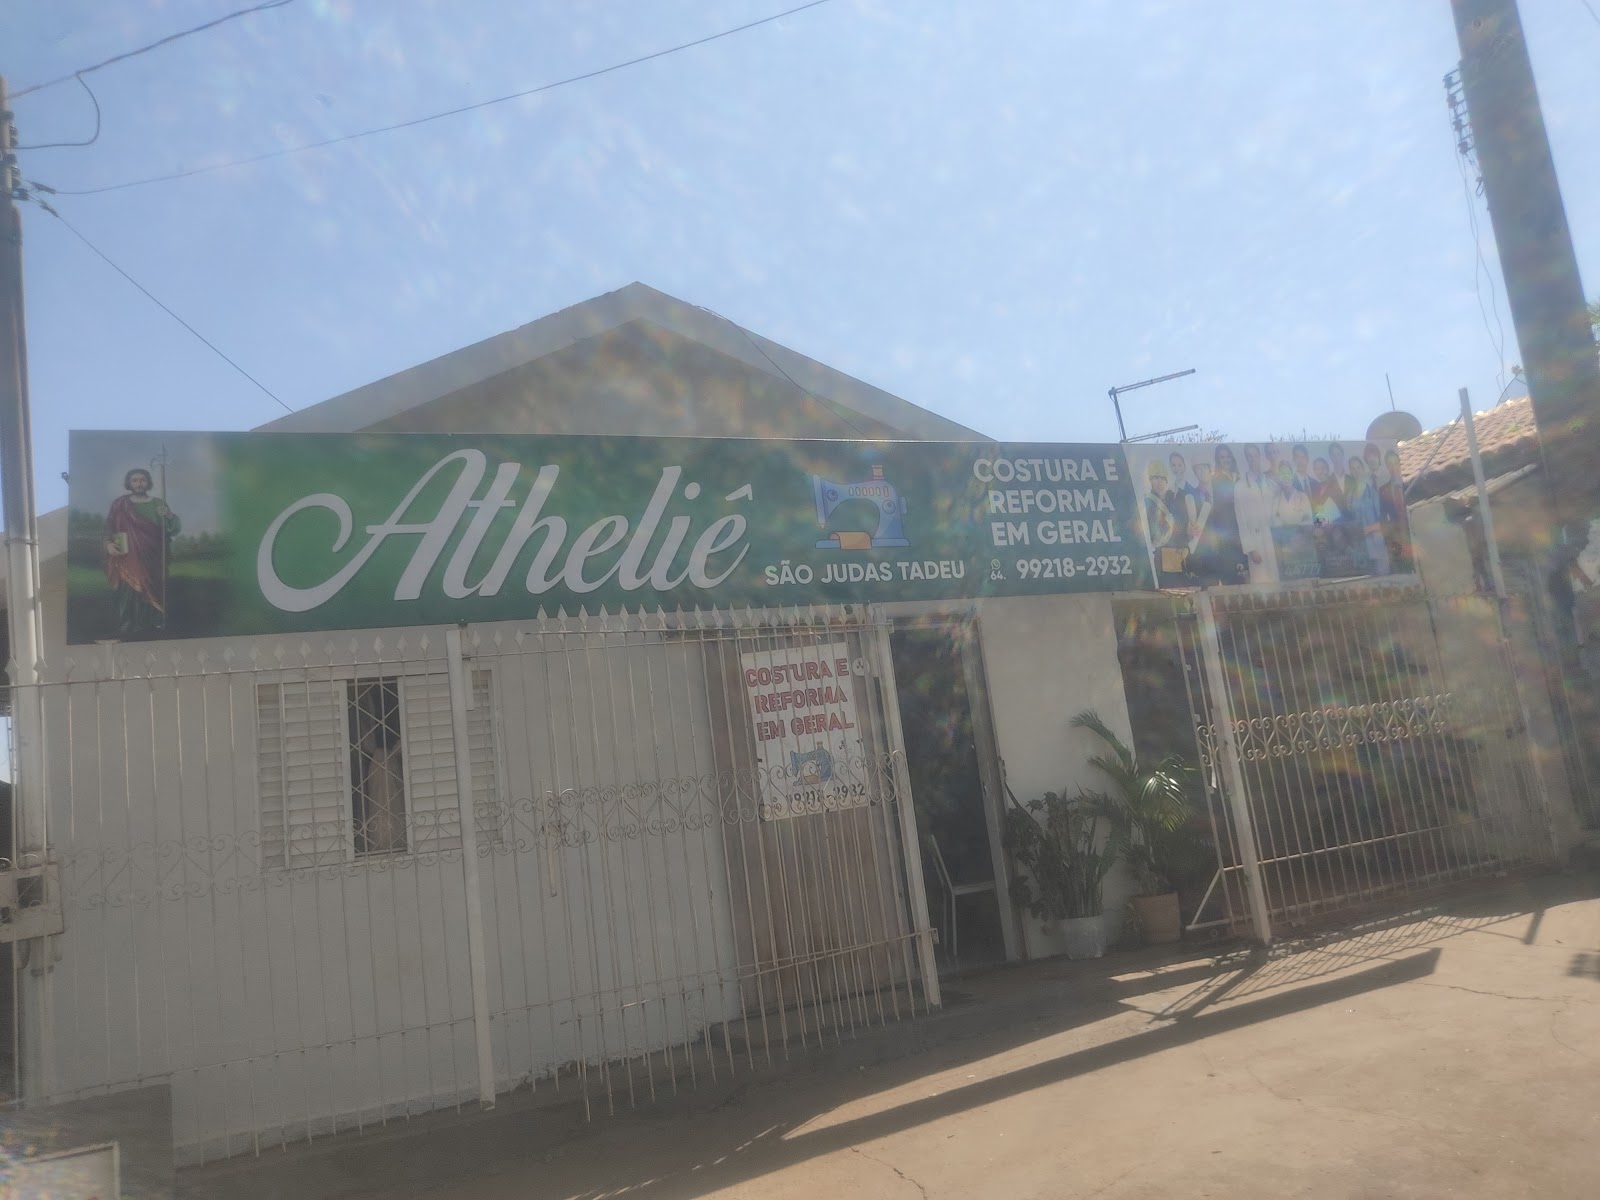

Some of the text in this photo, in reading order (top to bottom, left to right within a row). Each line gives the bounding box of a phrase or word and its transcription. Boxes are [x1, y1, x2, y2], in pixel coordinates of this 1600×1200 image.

[973, 457, 1119, 482] COSTURA E
[988, 489, 1115, 514] REFORMA
[991, 520, 1121, 546] EM GERAL
[765, 559, 965, 585] SÃO JUDAS TADEU
[1016, 555, 1133, 580] 99218-2932
[745, 658, 849, 688] COSTURA E
[754, 685, 848, 714] REFORMA
[756, 711, 855, 741] EM GERAL
